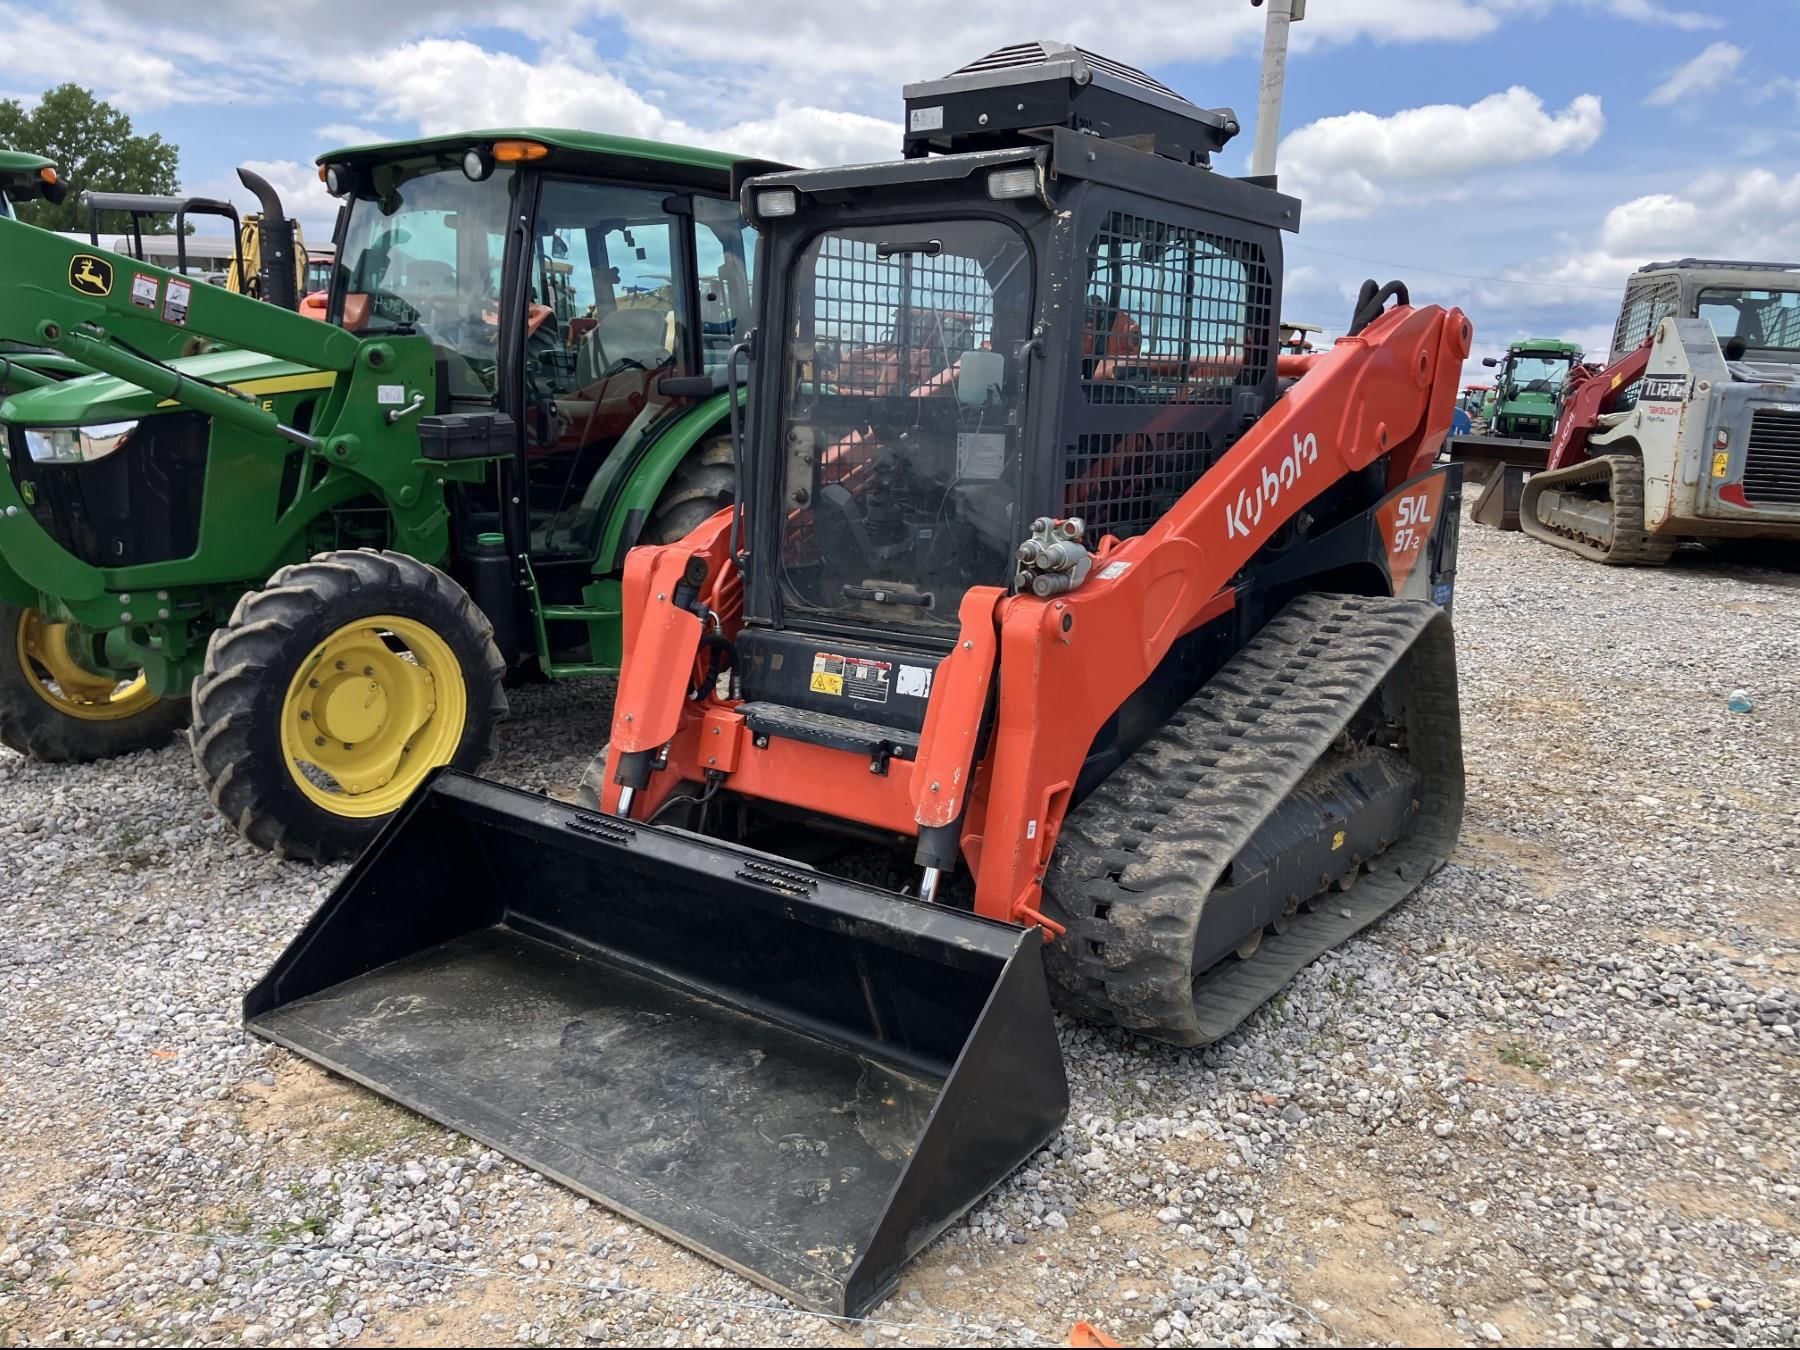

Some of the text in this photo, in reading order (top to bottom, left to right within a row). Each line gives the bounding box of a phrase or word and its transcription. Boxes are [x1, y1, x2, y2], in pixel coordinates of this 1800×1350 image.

[1548, 411, 1575, 473] AKEUCHI
[1226, 432, 1318, 540] Kubota
[1395, 495, 1431, 527] SVL
[1393, 528, 1420, 553] 97-2
